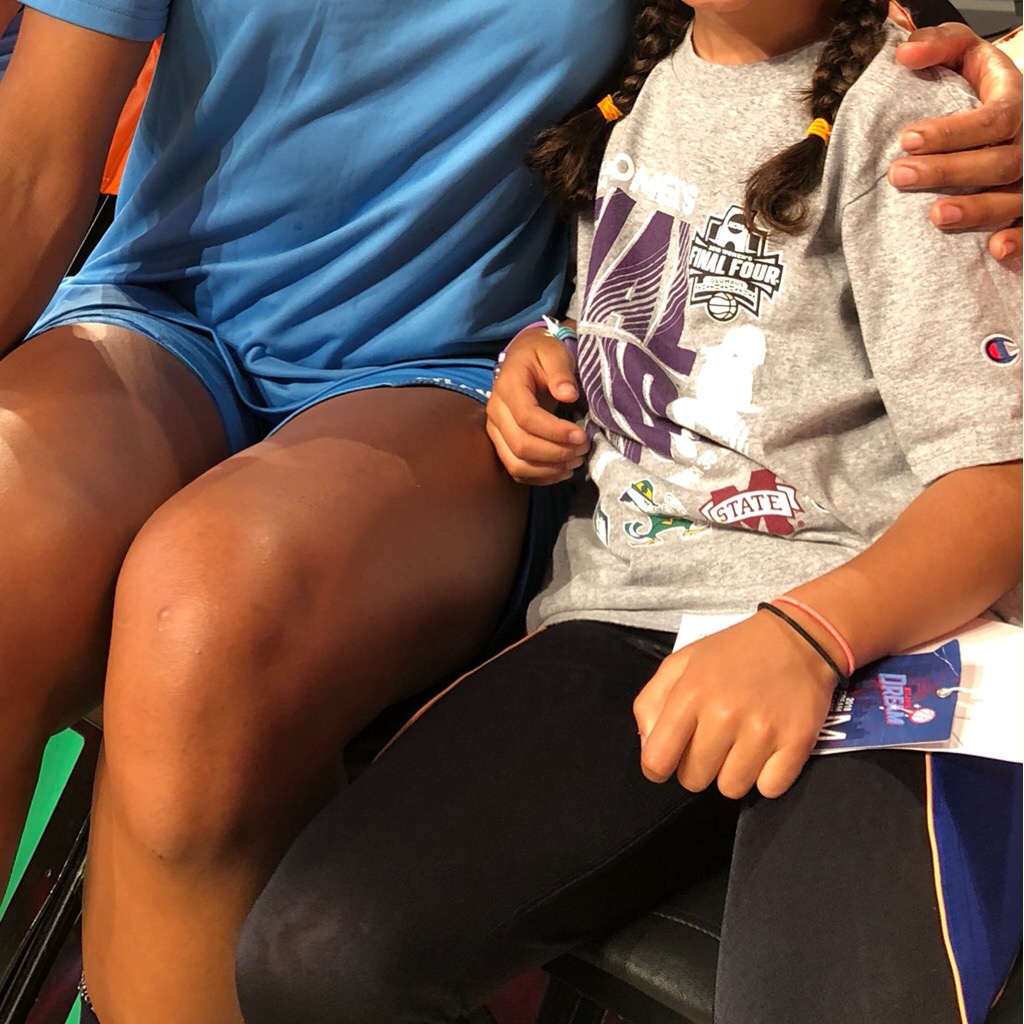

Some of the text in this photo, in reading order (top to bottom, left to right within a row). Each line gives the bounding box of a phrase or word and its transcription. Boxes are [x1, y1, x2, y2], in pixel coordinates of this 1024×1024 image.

[690, 245, 726, 275] FINAL
[716, 494, 782, 522] STATE
[878, 673, 907, 726] DREAM
